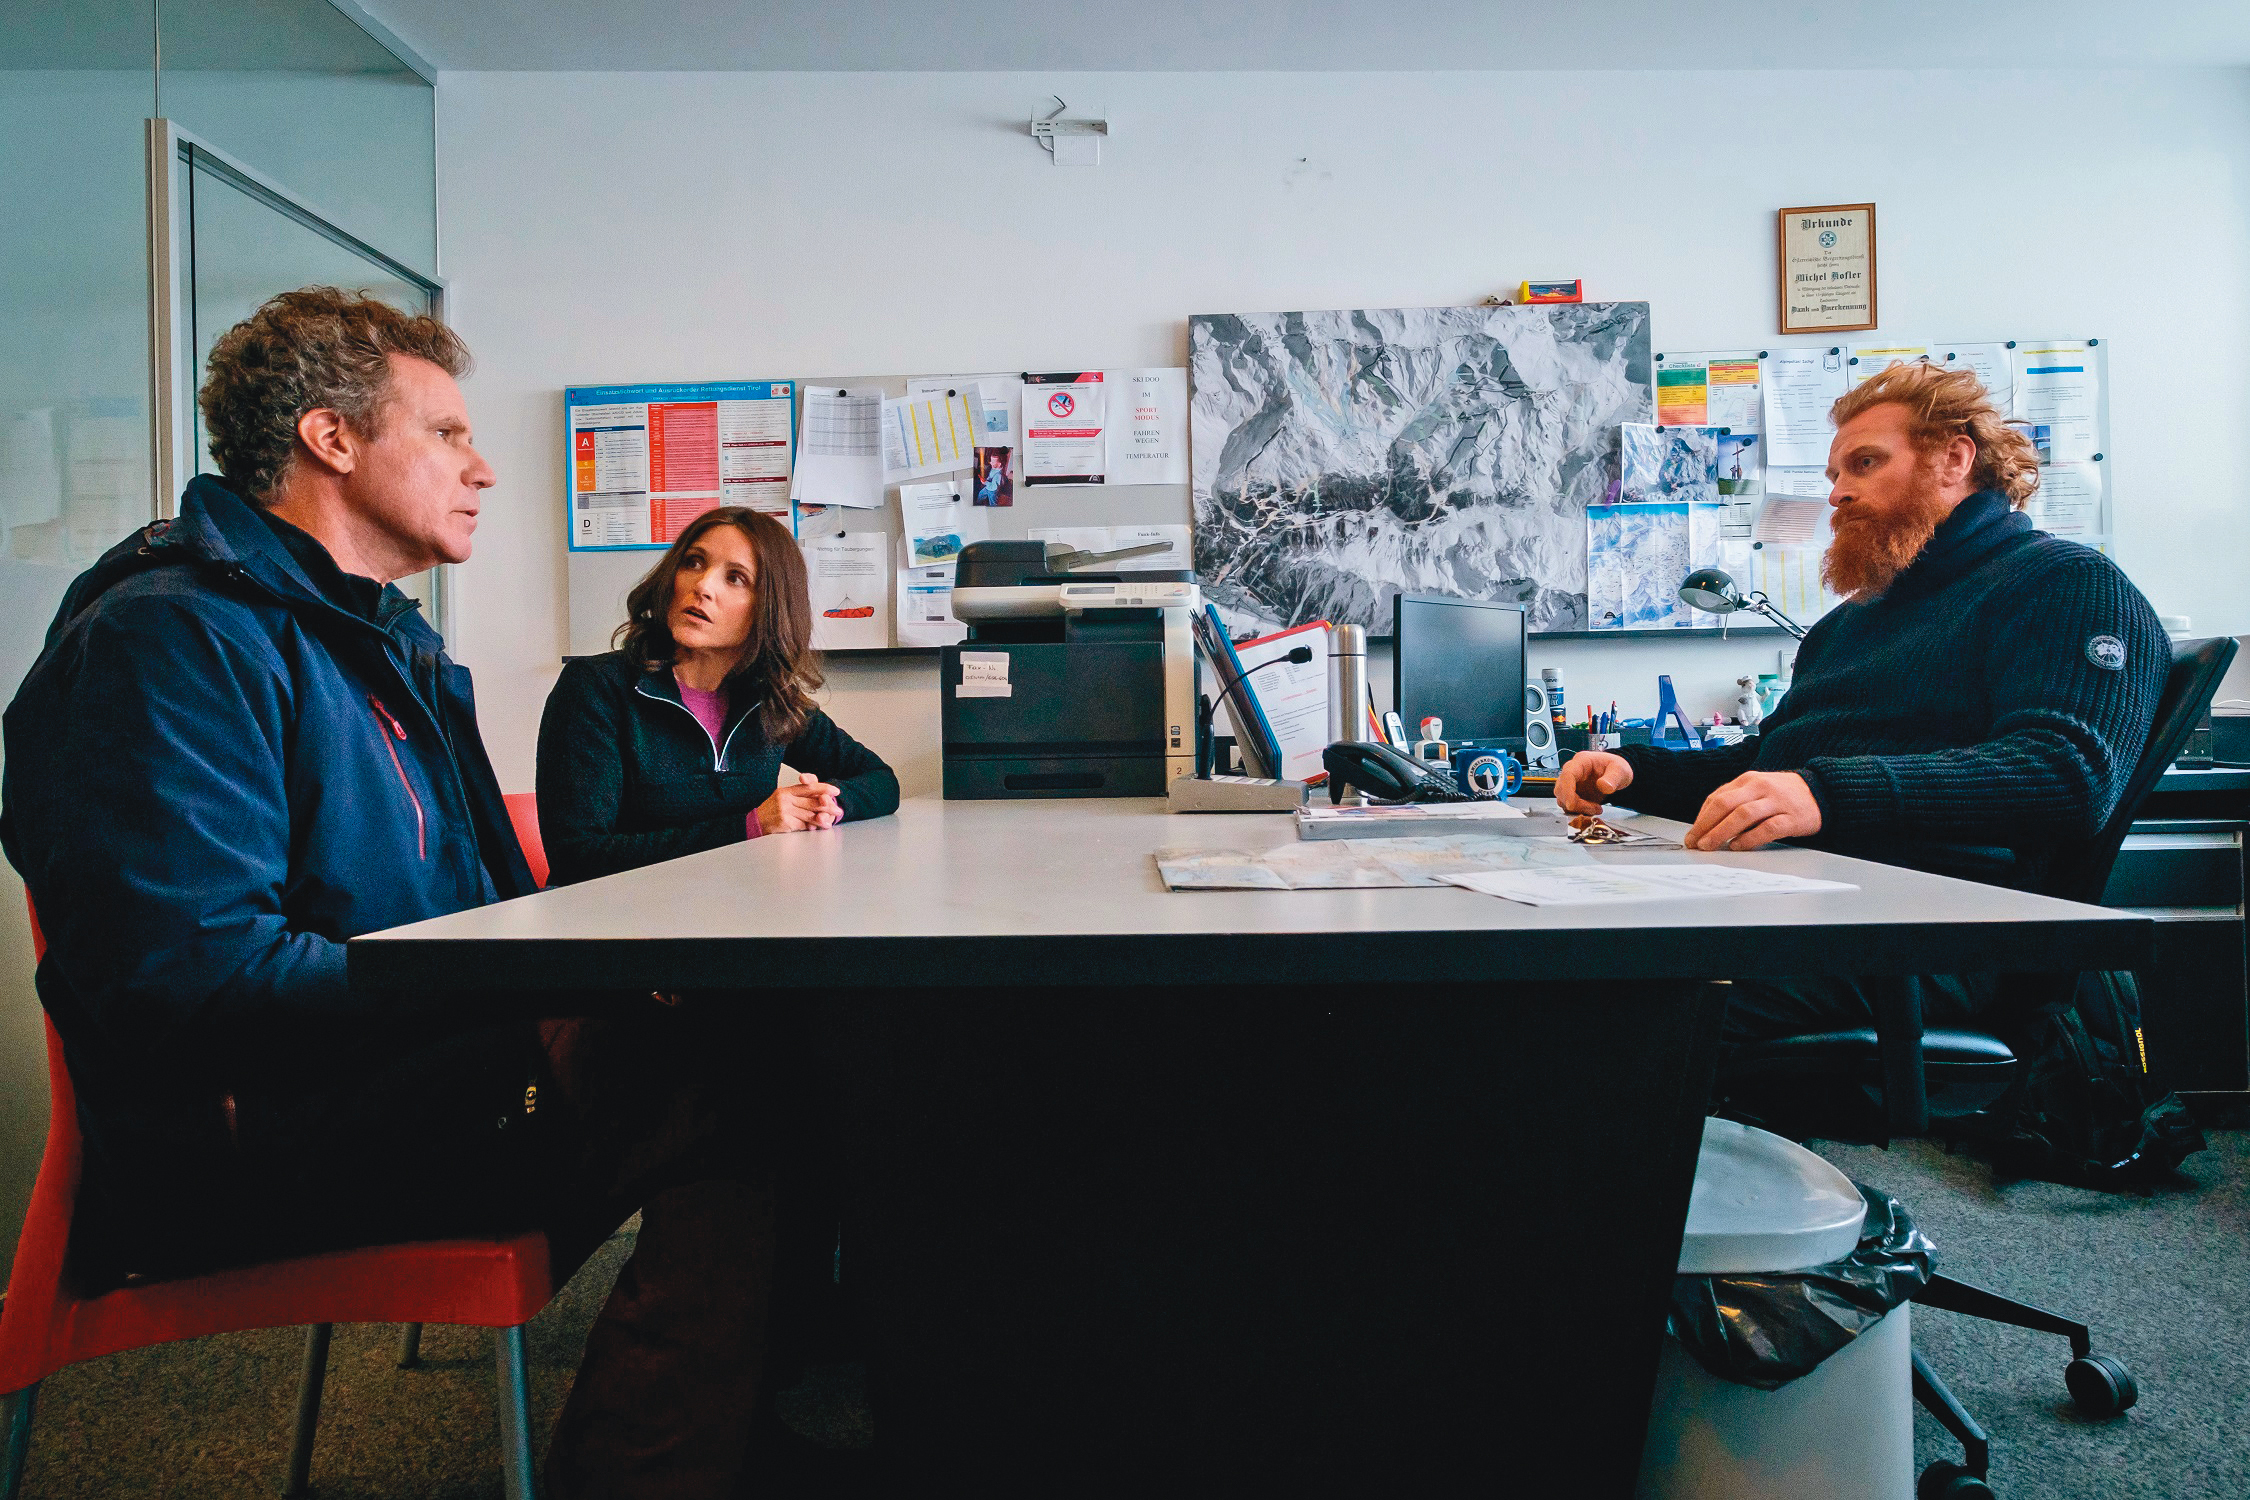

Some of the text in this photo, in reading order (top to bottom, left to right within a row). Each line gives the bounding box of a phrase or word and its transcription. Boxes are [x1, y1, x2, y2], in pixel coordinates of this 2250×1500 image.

[1801, 218, 1853, 231] Urkunde
[1794, 273, 1827, 283] Michel
[581, 438, 590, 447] A
[583, 520, 590, 528] D
[1176, 767, 1182, 775] 2
